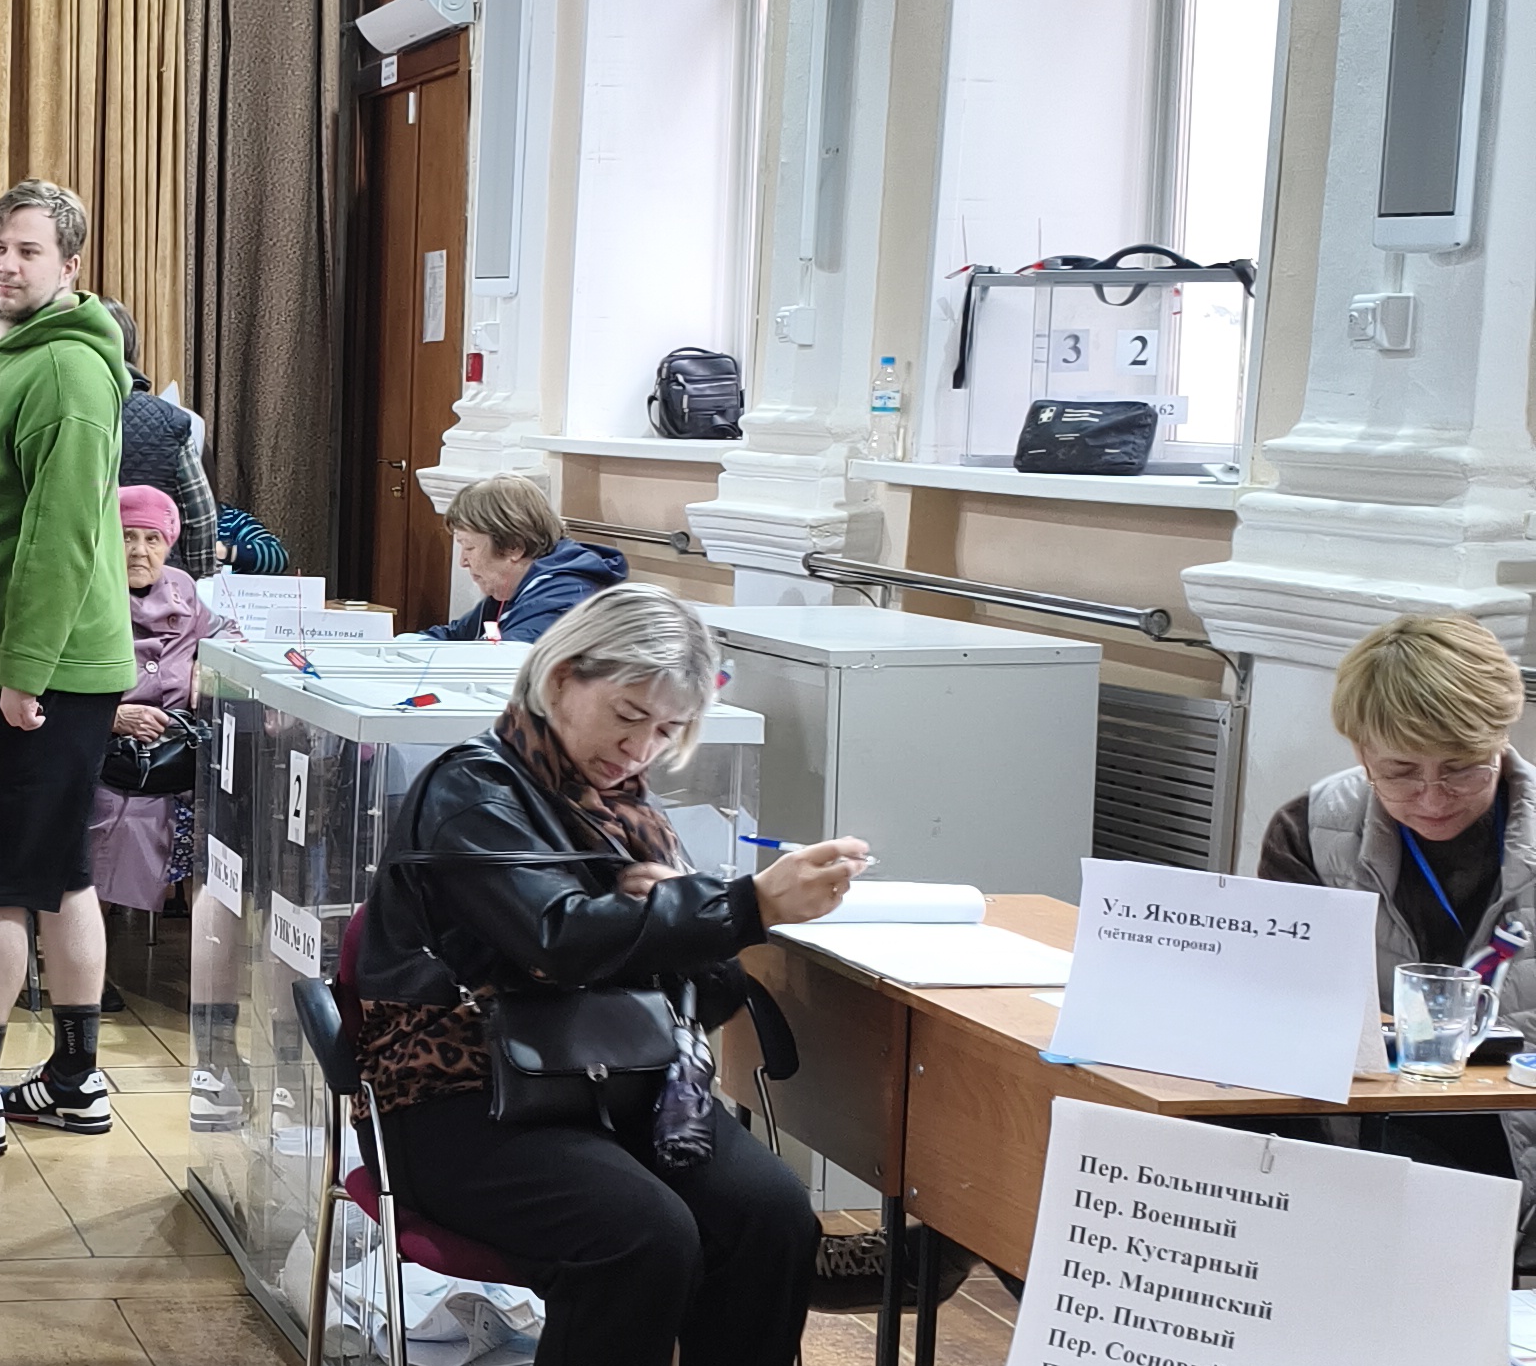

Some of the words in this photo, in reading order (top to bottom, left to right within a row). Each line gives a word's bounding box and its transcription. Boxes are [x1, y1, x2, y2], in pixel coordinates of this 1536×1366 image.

[1062, 334, 1081, 364] 3
[1128, 335, 1149, 366] 2
[275, 626, 295, 637] Пер.
[293, 774, 302, 819] 2
[1102, 897, 1137, 919] Ул.
[1143, 903, 1259, 937] Яковлева,
[1097, 925, 1154, 945] (чётная
[1157, 936, 1222, 955] сторона)
[1077, 1154, 1128, 1183] Пер.
[1136, 1165, 1290, 1212] Больничный
[1072, 1189, 1123, 1219] Пер.
[1131, 1200, 1237, 1238] Военный
[1067, 1224, 1118, 1253] Пер.
[1125, 1235, 1259, 1281] Кустарный
[1061, 1258, 1111, 1288] Пер.
[1119, 1270, 1273, 1321] Мариинский
[1047, 1327, 1096, 1358] Пер.
[1054, 1293, 1104, 1323] Пер.
[1112, 1305, 1235, 1350] Пихтовый
